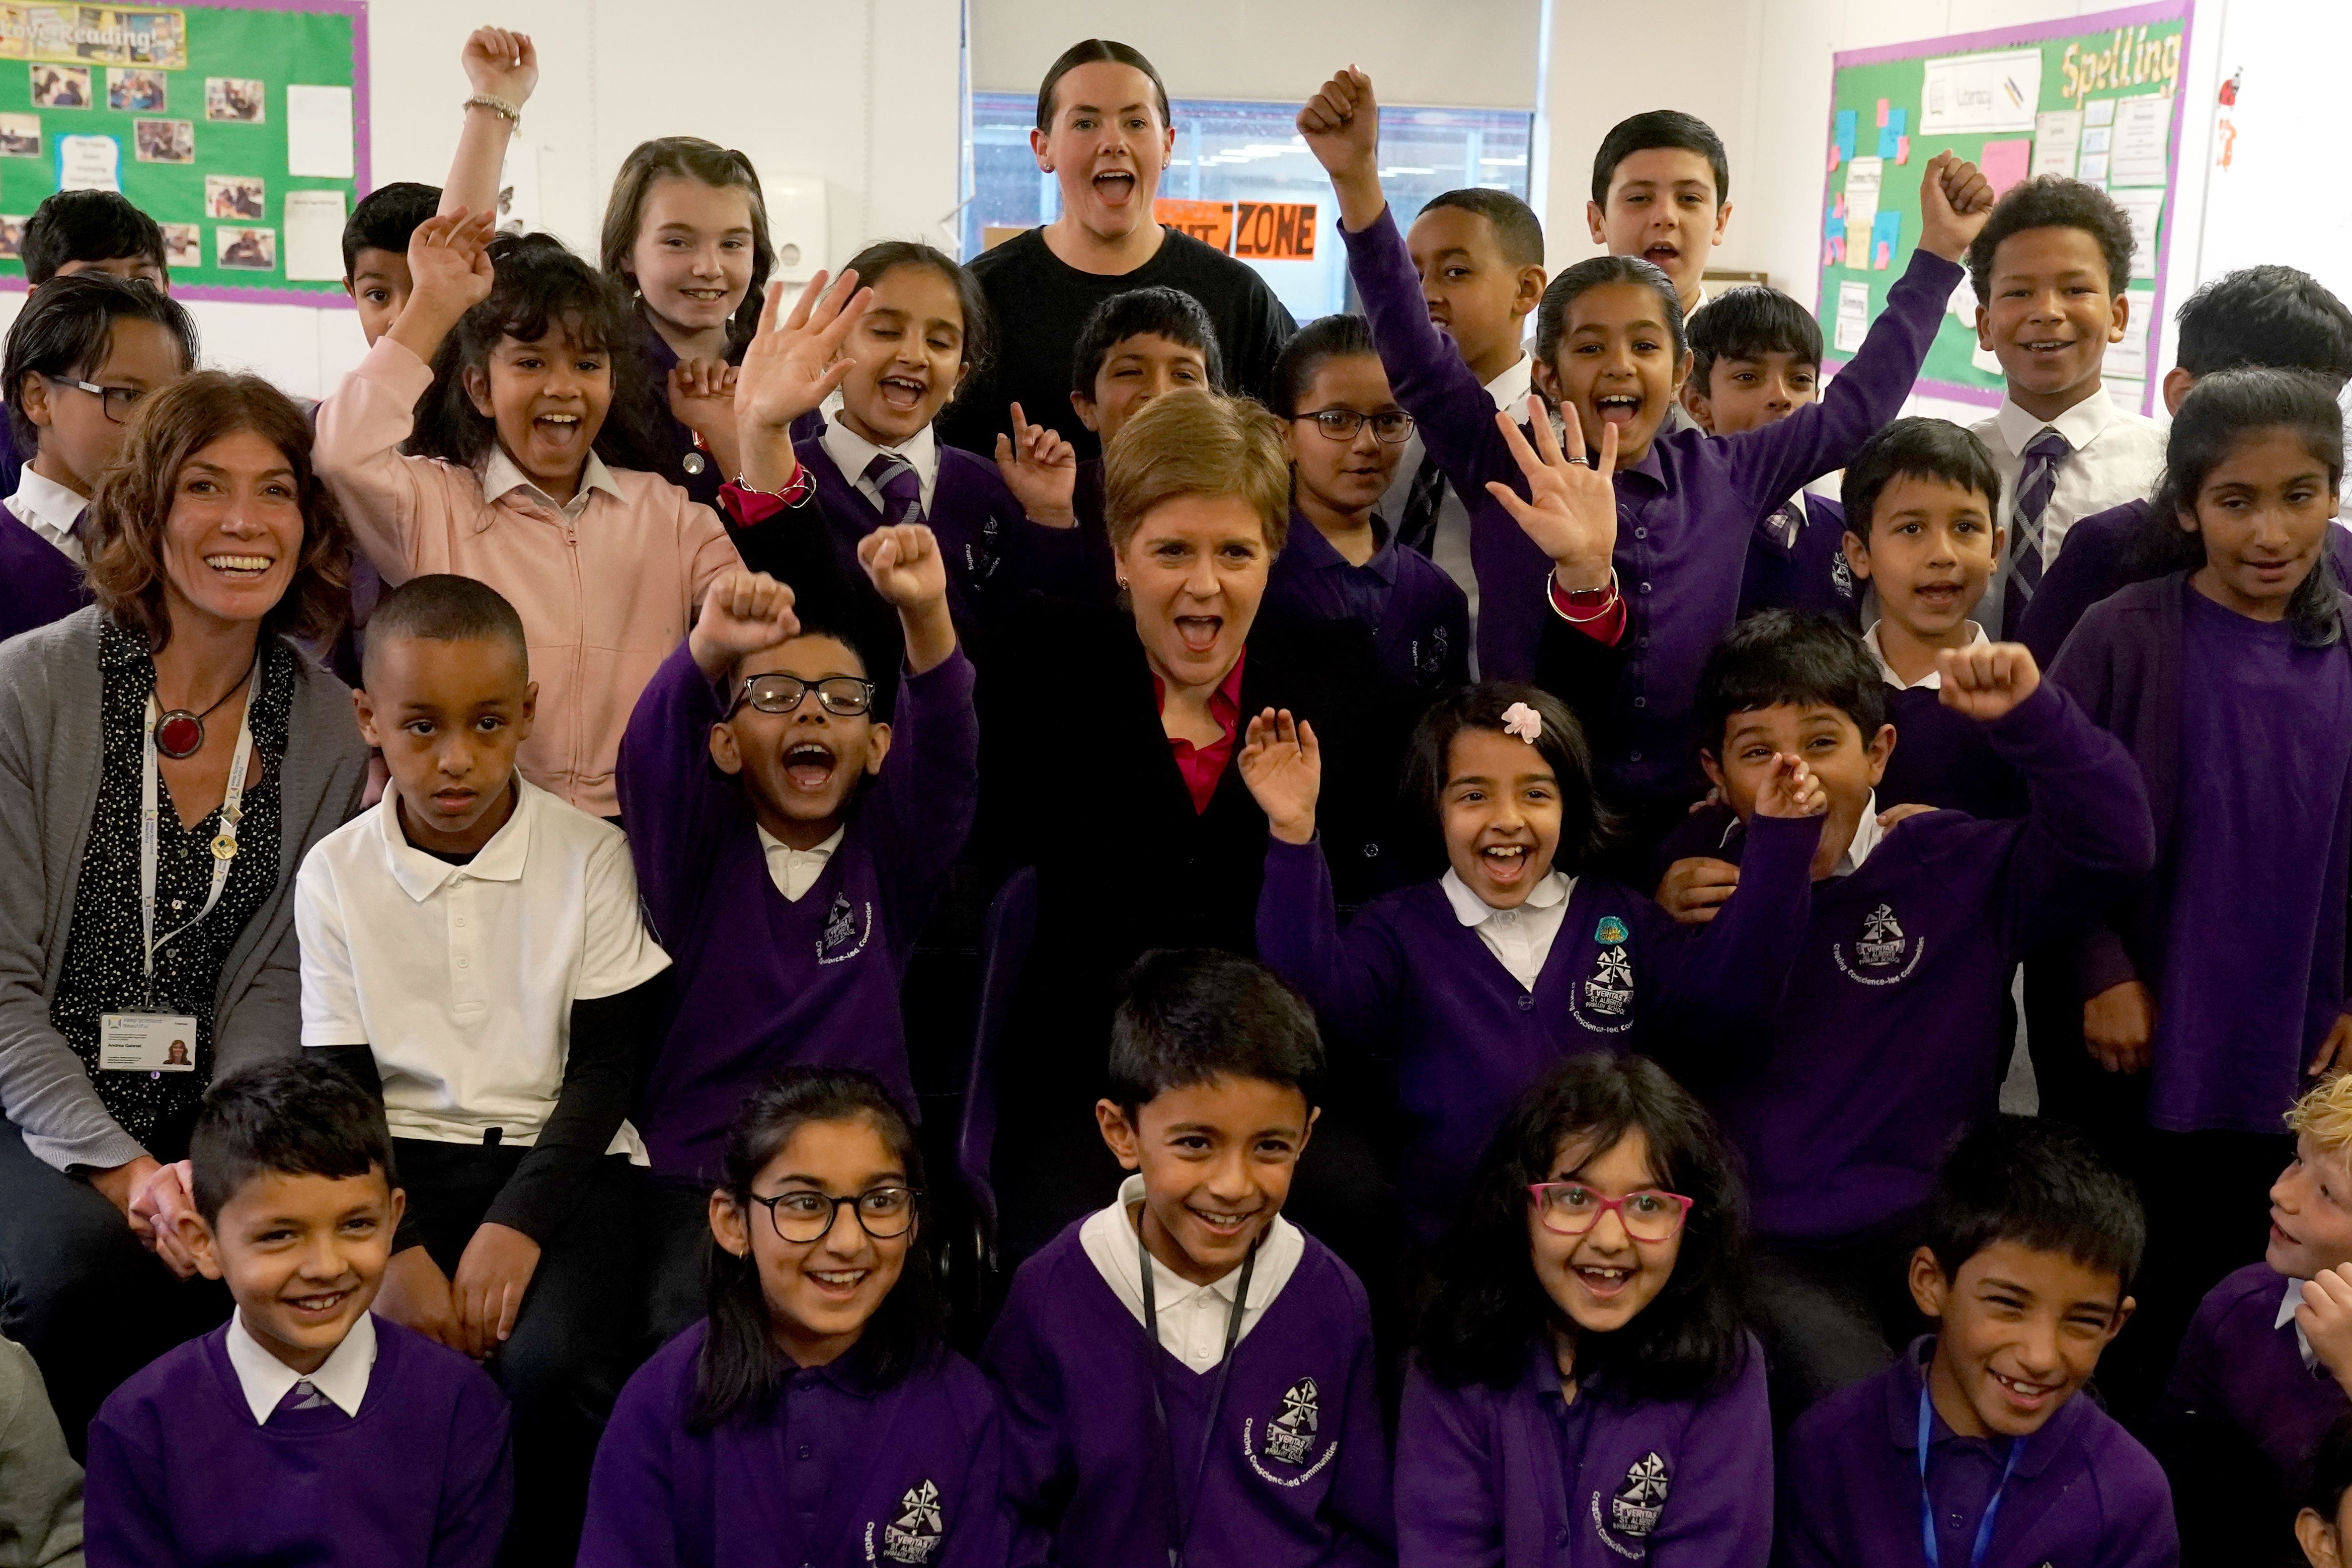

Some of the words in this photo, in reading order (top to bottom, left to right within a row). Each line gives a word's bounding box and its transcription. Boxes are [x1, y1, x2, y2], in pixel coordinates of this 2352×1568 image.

[59, 24, 156, 53] Reading!
[2062, 26, 2182, 111] Spelling
[1222, 204, 1315, 255] ZONE
[1596, 990, 1623, 1001] VERITAS
[1599, 997, 1623, 1007] ALBERTS
[1279, 1434, 1305, 1448] VERITAS
[898, 1535, 928, 1550] VERITAS
